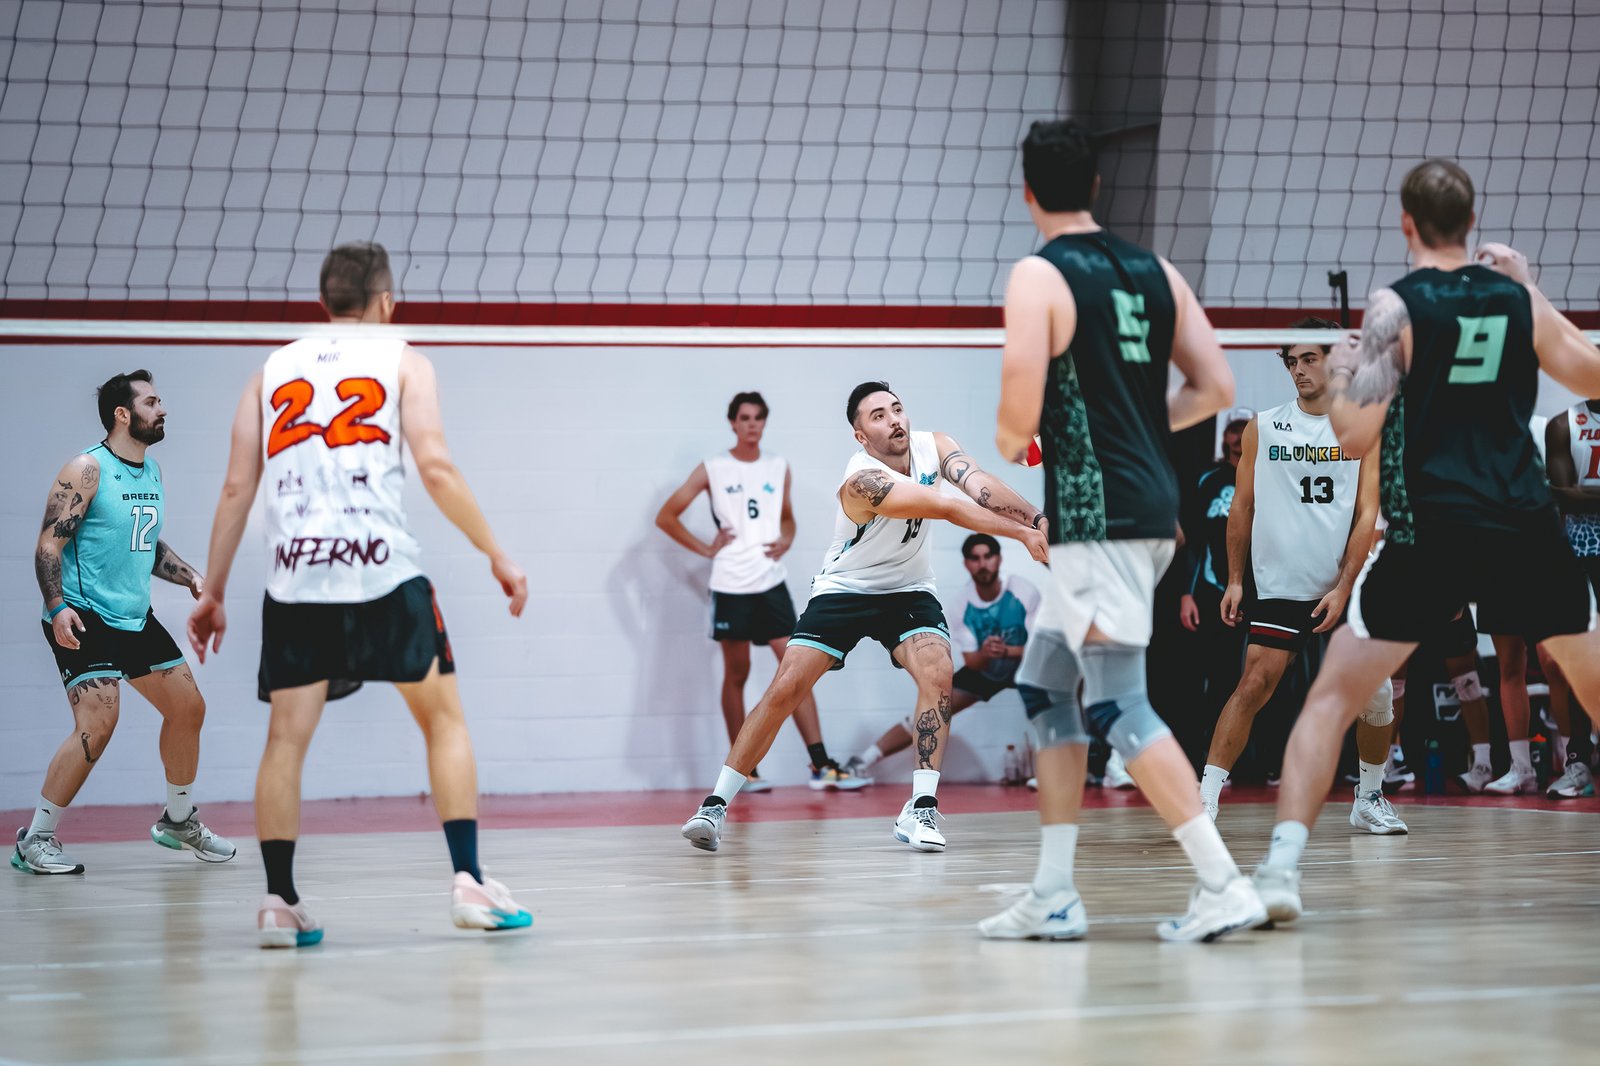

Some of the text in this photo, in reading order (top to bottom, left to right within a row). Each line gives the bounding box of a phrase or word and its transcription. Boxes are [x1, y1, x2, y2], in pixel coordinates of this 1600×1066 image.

[1110, 288, 1152, 364] 5
[1448, 314, 1509, 384] 9
[267, 377, 391, 460] 22
[1273, 421, 1292, 431] VLA
[1269, 443, 1360, 465] SLUNKE
[122, 493, 160, 501] BREEZE
[1300, 476, 1334, 504] 13
[747, 498, 759, 520] 6
[130, 505, 159, 552] 12
[275, 531, 390, 576] INFERNO
